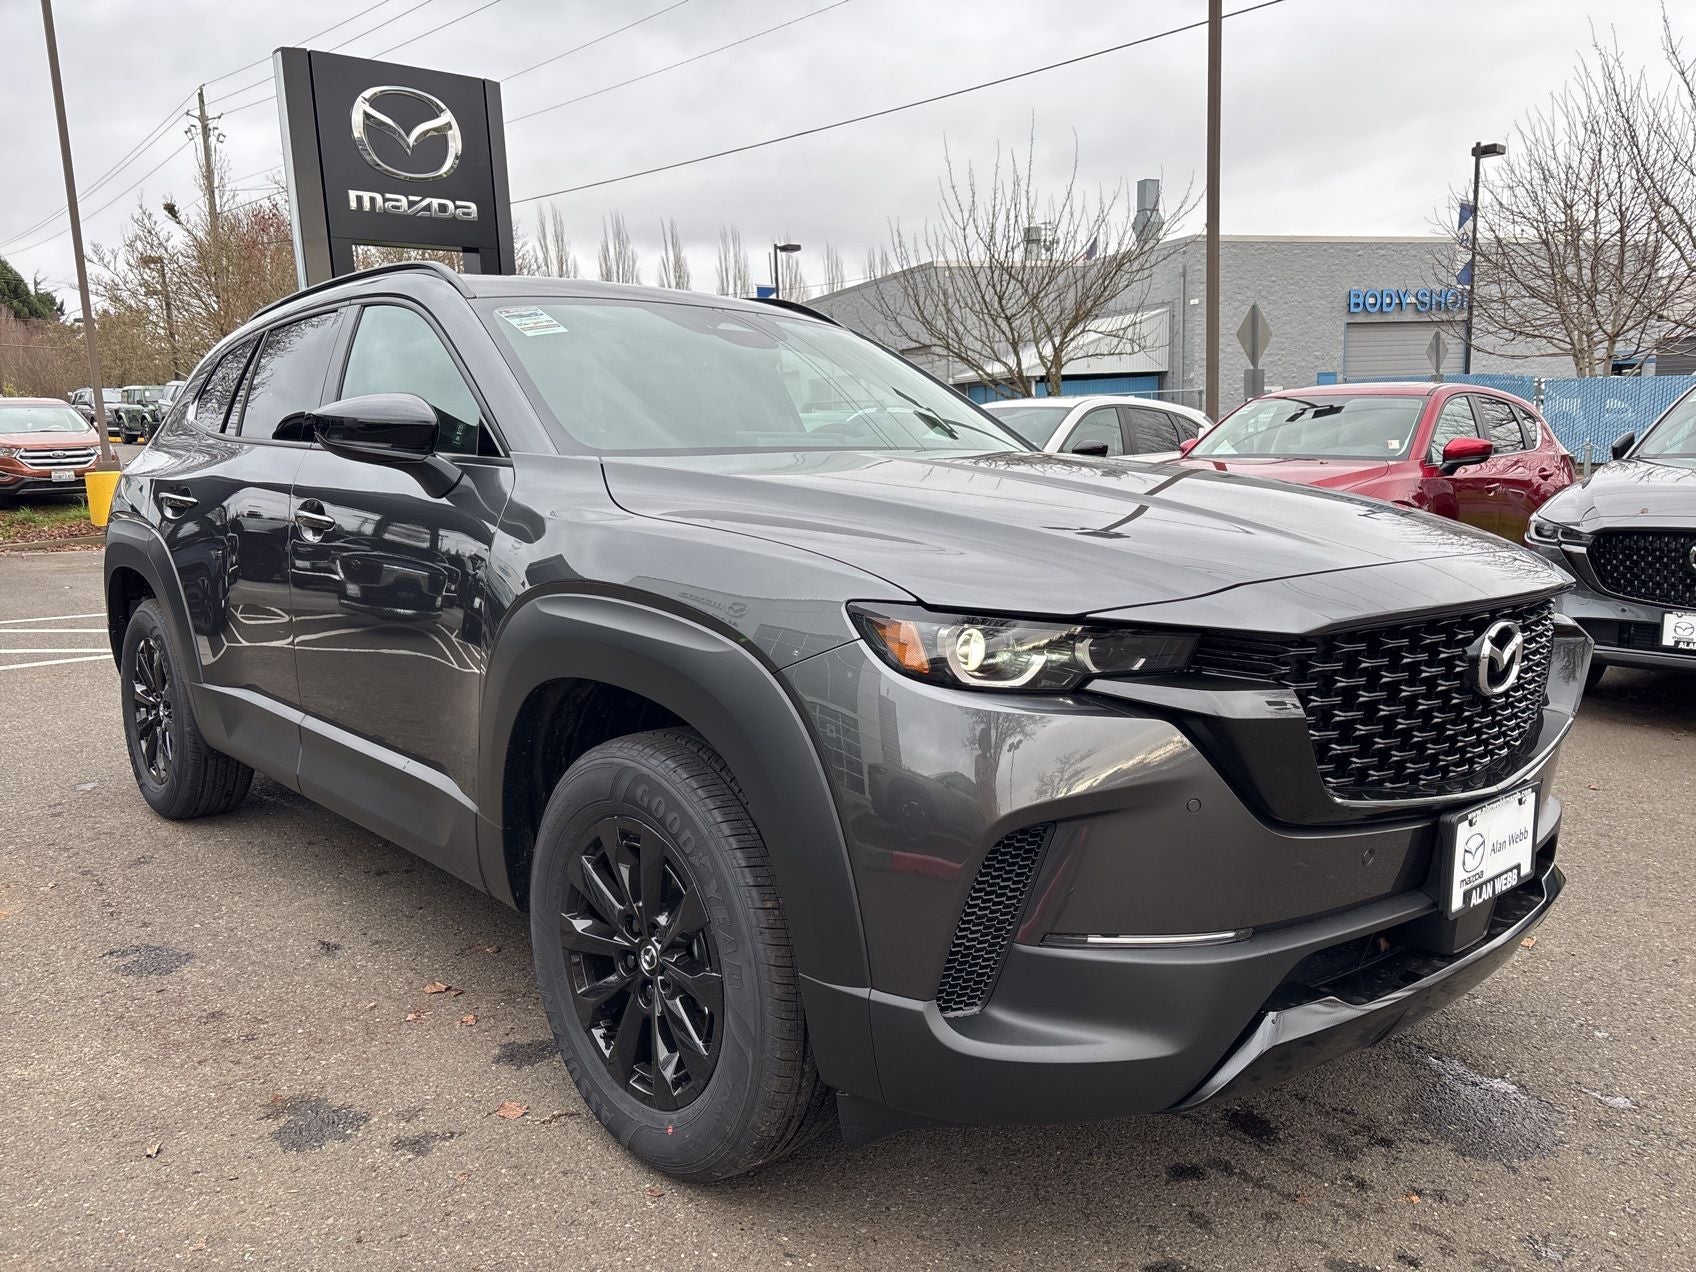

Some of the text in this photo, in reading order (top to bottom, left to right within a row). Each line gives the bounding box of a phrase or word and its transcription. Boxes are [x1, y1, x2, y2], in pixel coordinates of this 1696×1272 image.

[1349, 287, 1410, 313] BODY
[1490, 826, 1529, 857] Alan Webb
[635, 782, 744, 991] GOODYEAR
[1470, 868, 1518, 908] ALAN WEBB
